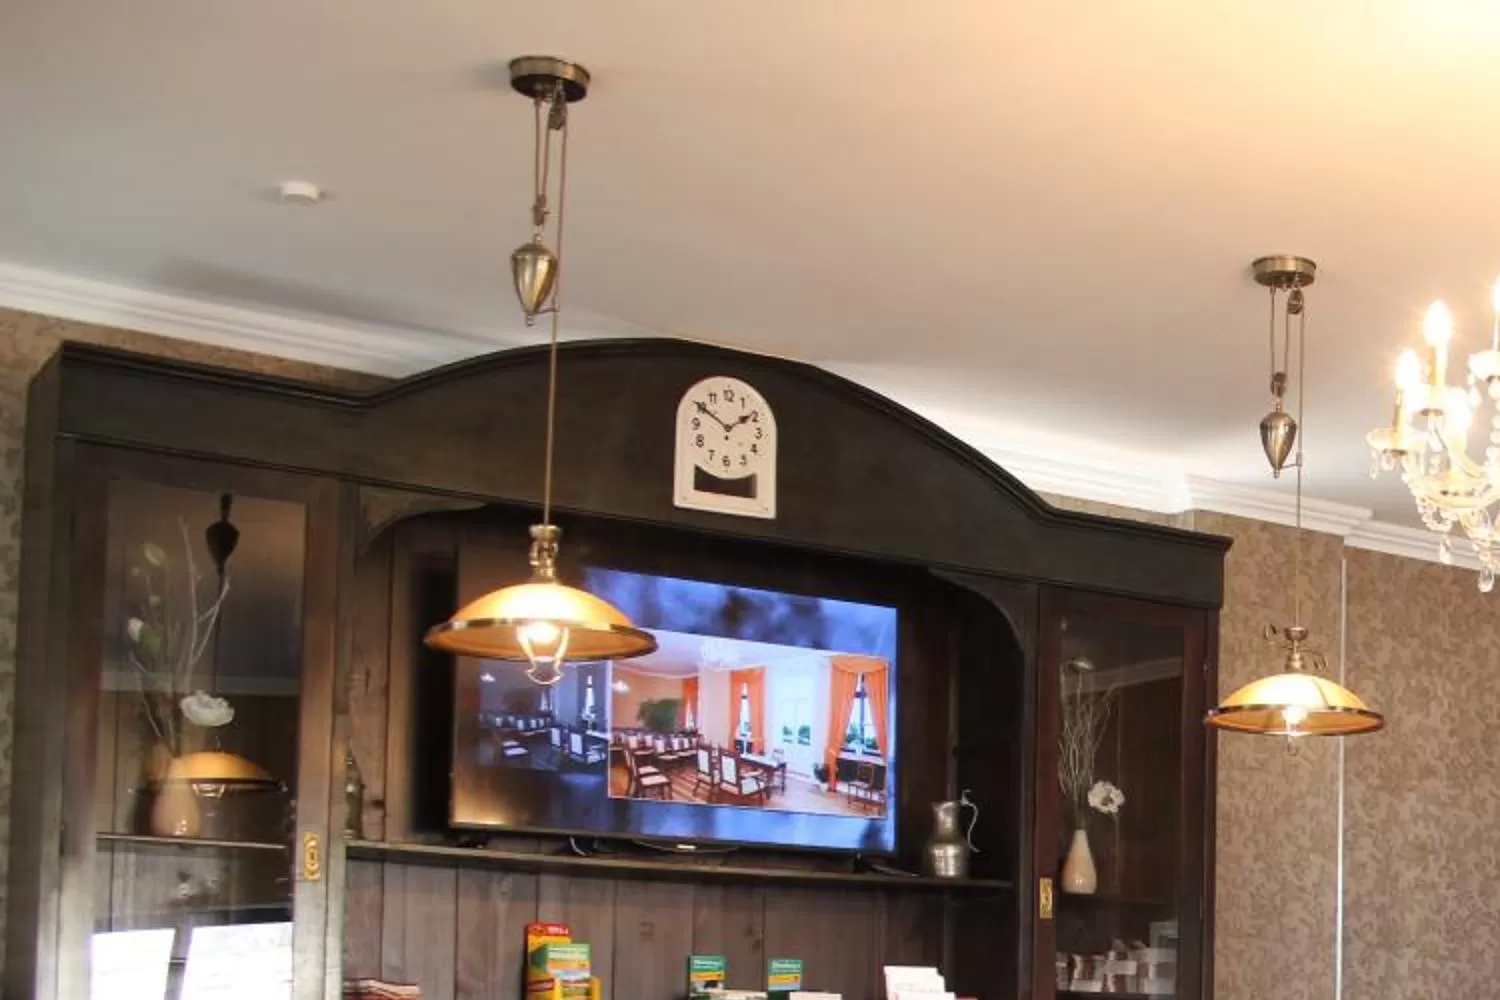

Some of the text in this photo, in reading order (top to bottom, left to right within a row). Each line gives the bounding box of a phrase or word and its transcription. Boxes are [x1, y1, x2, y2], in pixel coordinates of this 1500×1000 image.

[708, 392, 717, 404] 11
[723, 389, 735, 403] 12
[740, 397, 745, 409] 1
[751, 410, 759, 423] 2
[692, 417, 701, 431] 9
[755, 427, 762, 440] 3
[696, 433, 705, 448] 8
[708, 449, 715, 461] 7
[750, 443, 758, 455] 4
[722, 455, 731, 467] 6
[739, 454, 747, 466] 5
